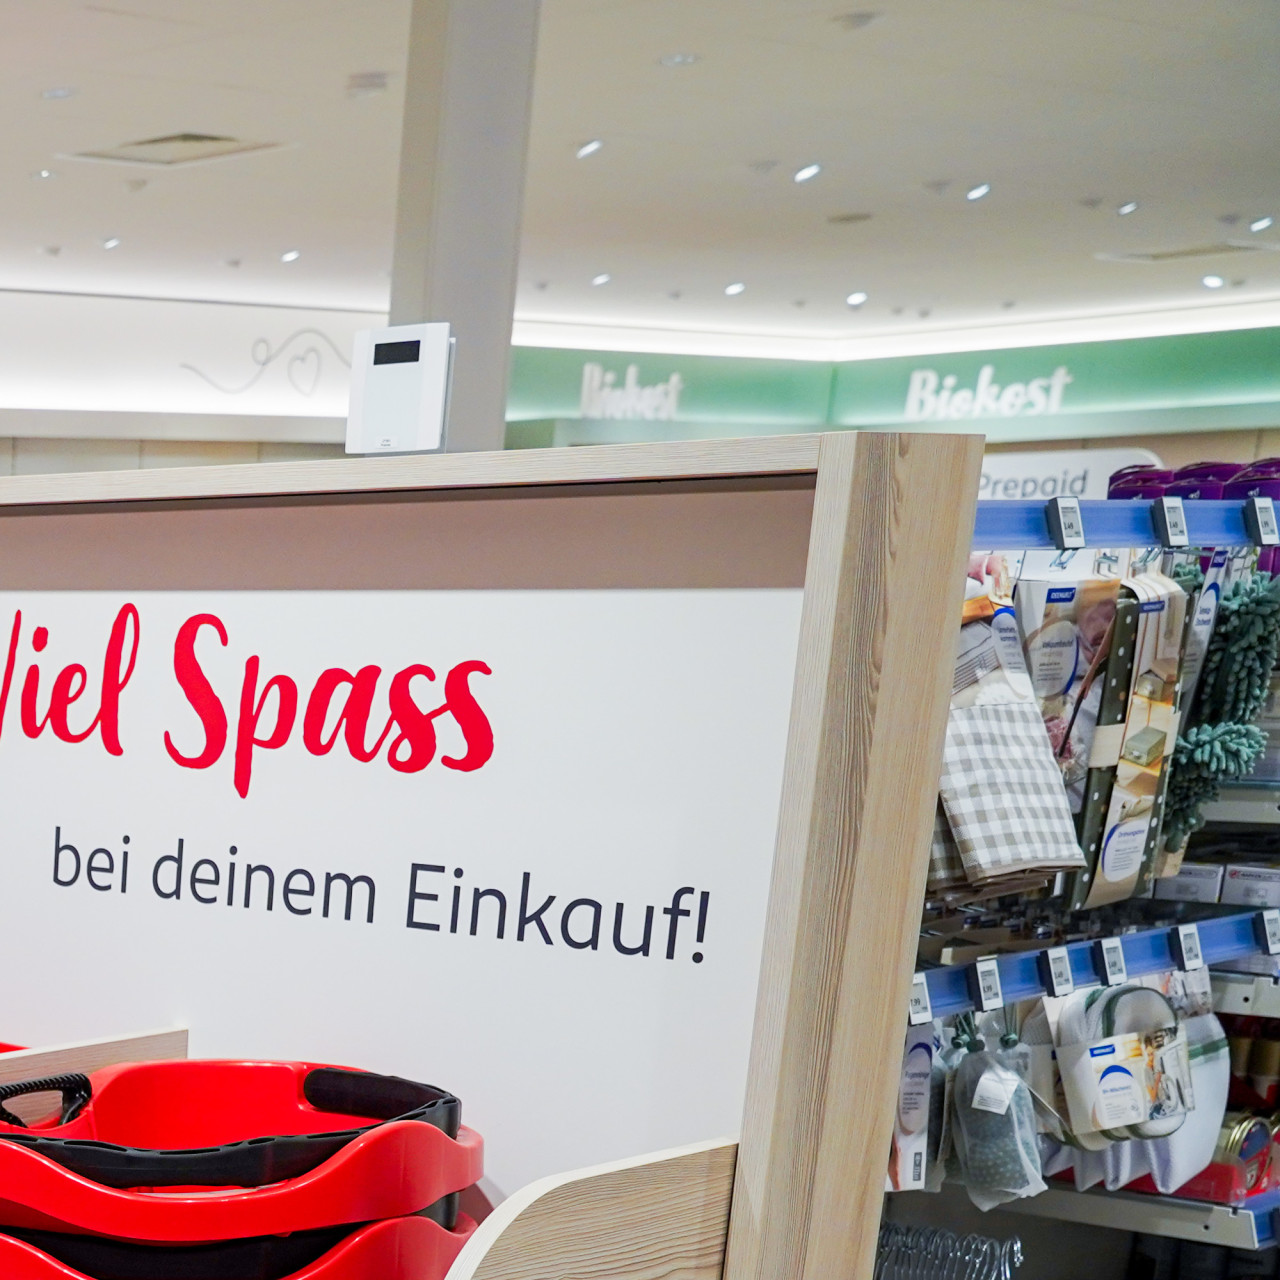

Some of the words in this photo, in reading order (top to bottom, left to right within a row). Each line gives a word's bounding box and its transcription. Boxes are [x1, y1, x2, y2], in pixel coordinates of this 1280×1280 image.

[903, 364, 1075, 422] Biokost
[978, 468, 1090, 498] Prepaid
[164, 613, 494, 798] Spass
[54, 827, 130, 893] bei
[153, 839, 375, 923] deinem
[407, 863, 709, 963] Einkauf!
